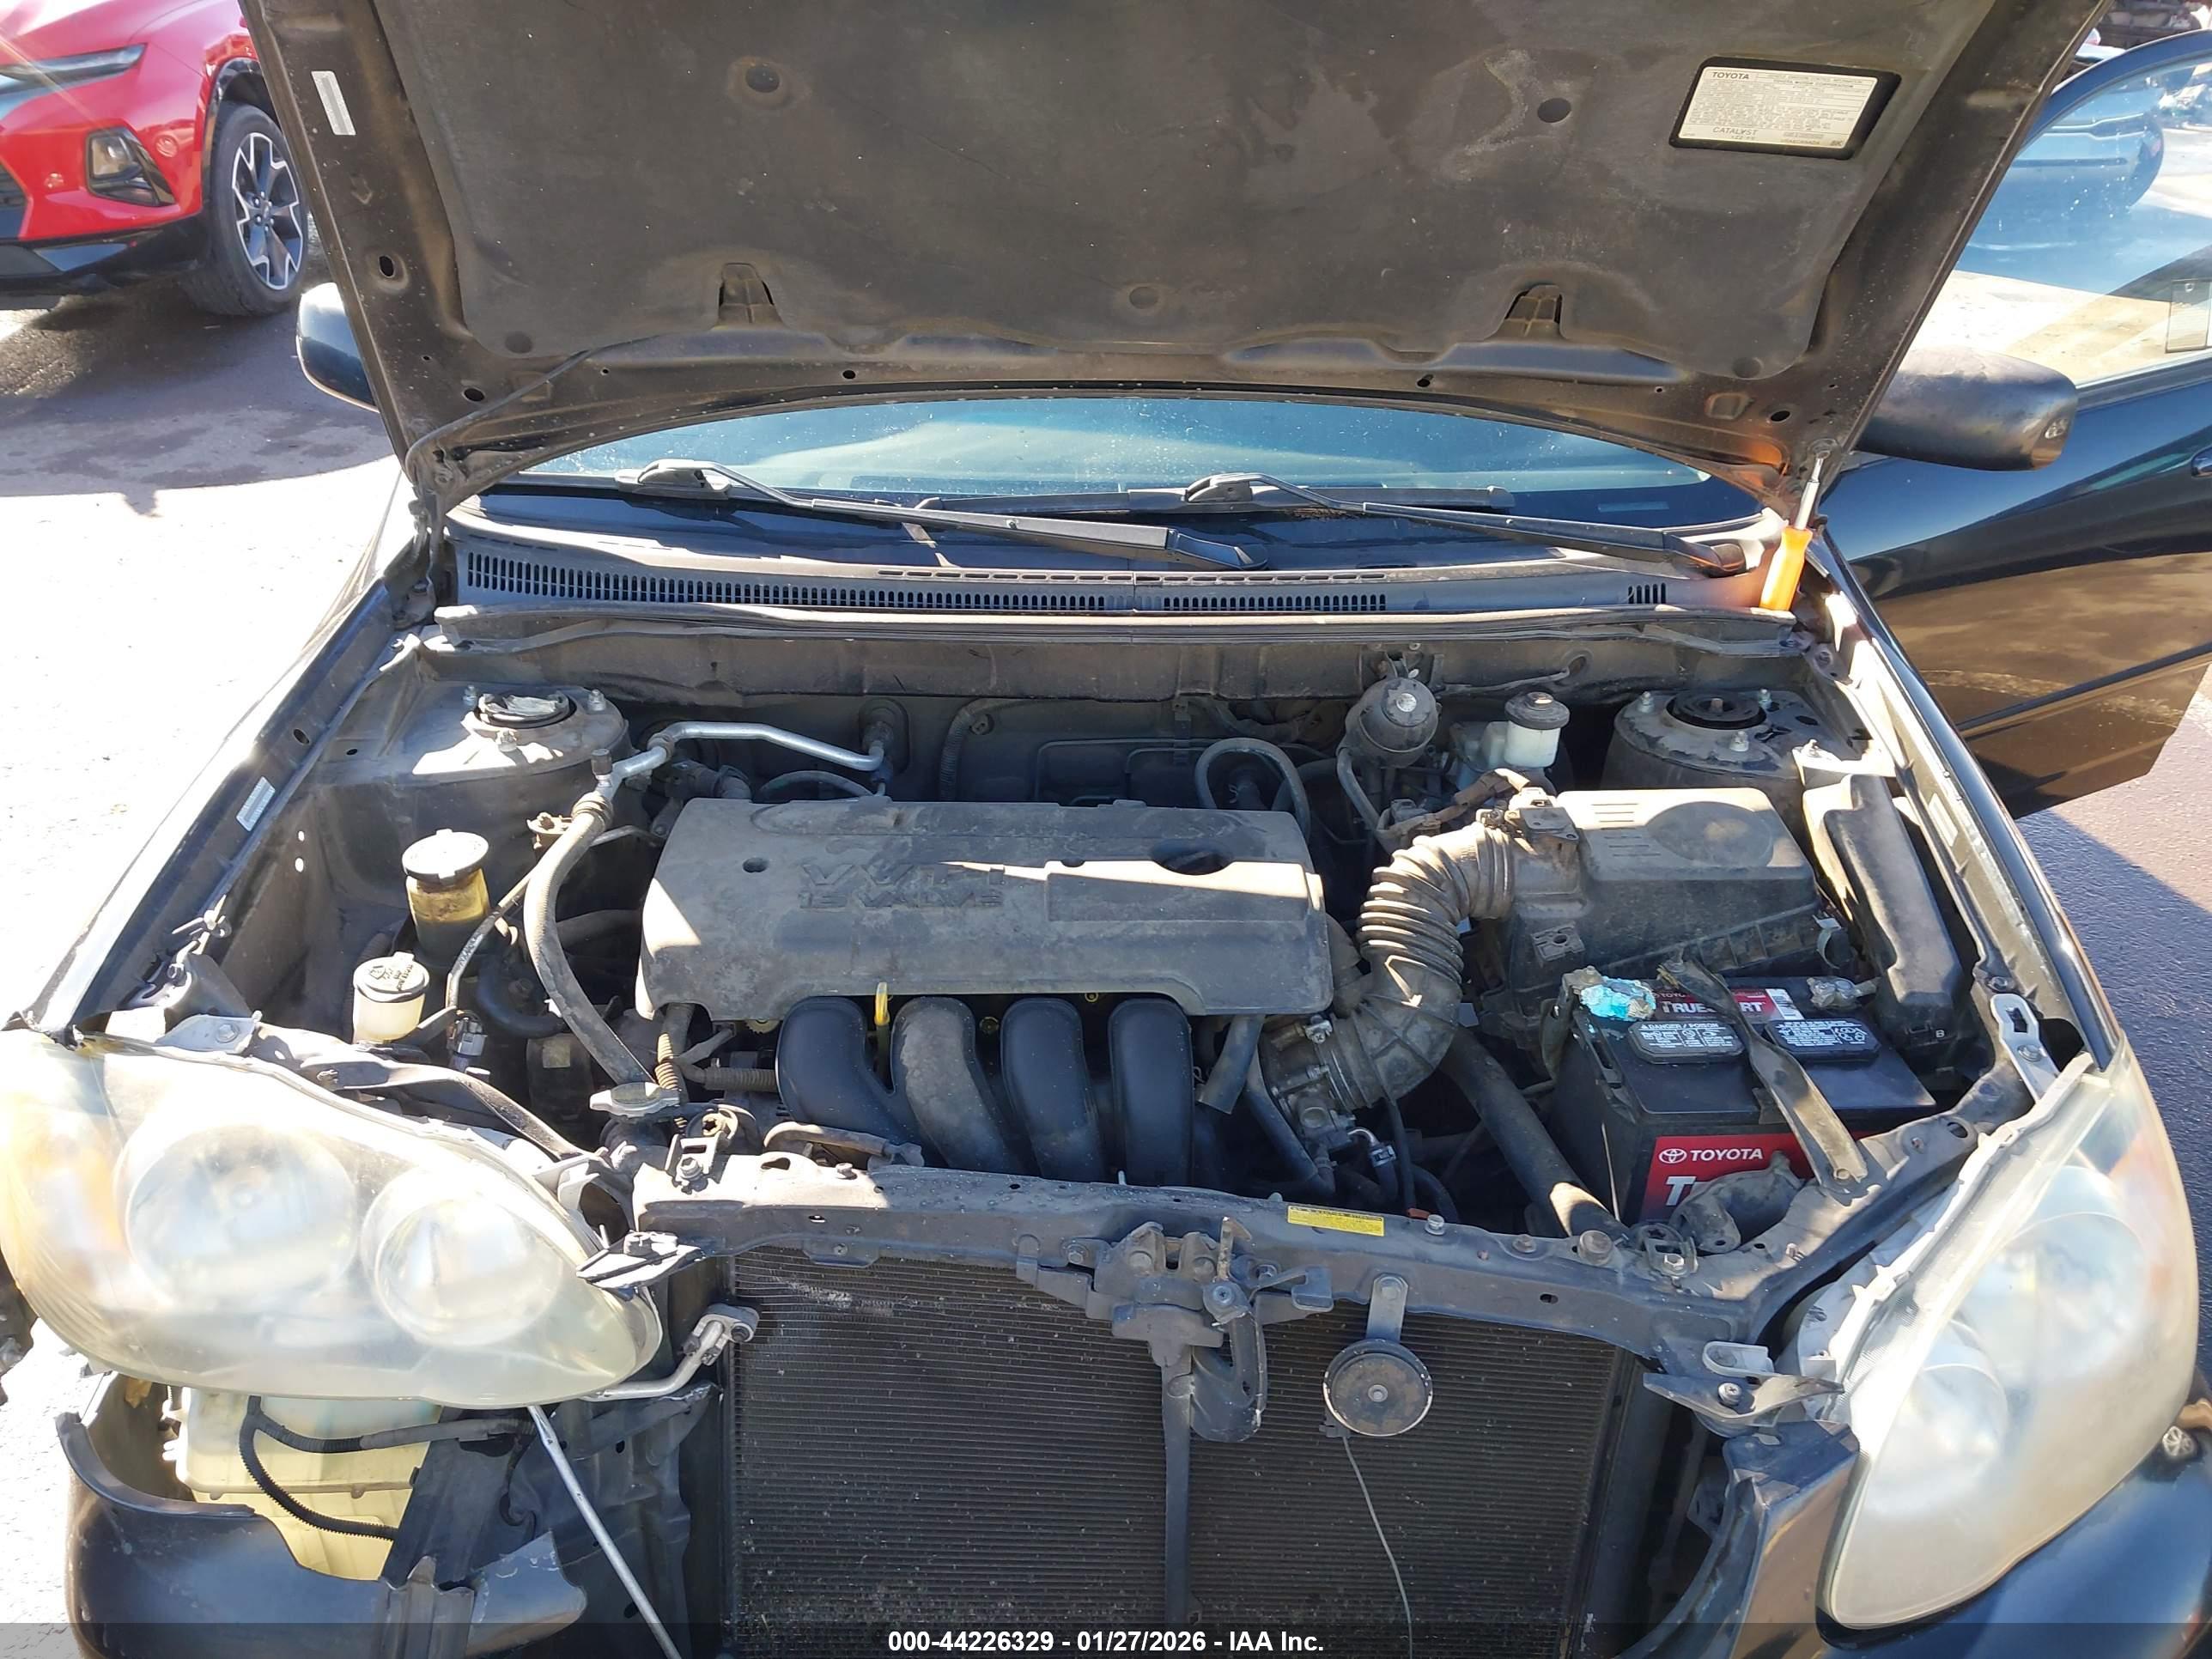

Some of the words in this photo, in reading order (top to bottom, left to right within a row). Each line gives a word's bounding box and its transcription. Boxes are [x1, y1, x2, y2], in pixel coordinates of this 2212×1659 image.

[1712, 71, 1749, 80] TOYOTA
[1712, 127, 1759, 137] CATALYST
[1936, 1030, 1945, 1038] B
[1689, 1148, 1763, 1161] TOYOTA
